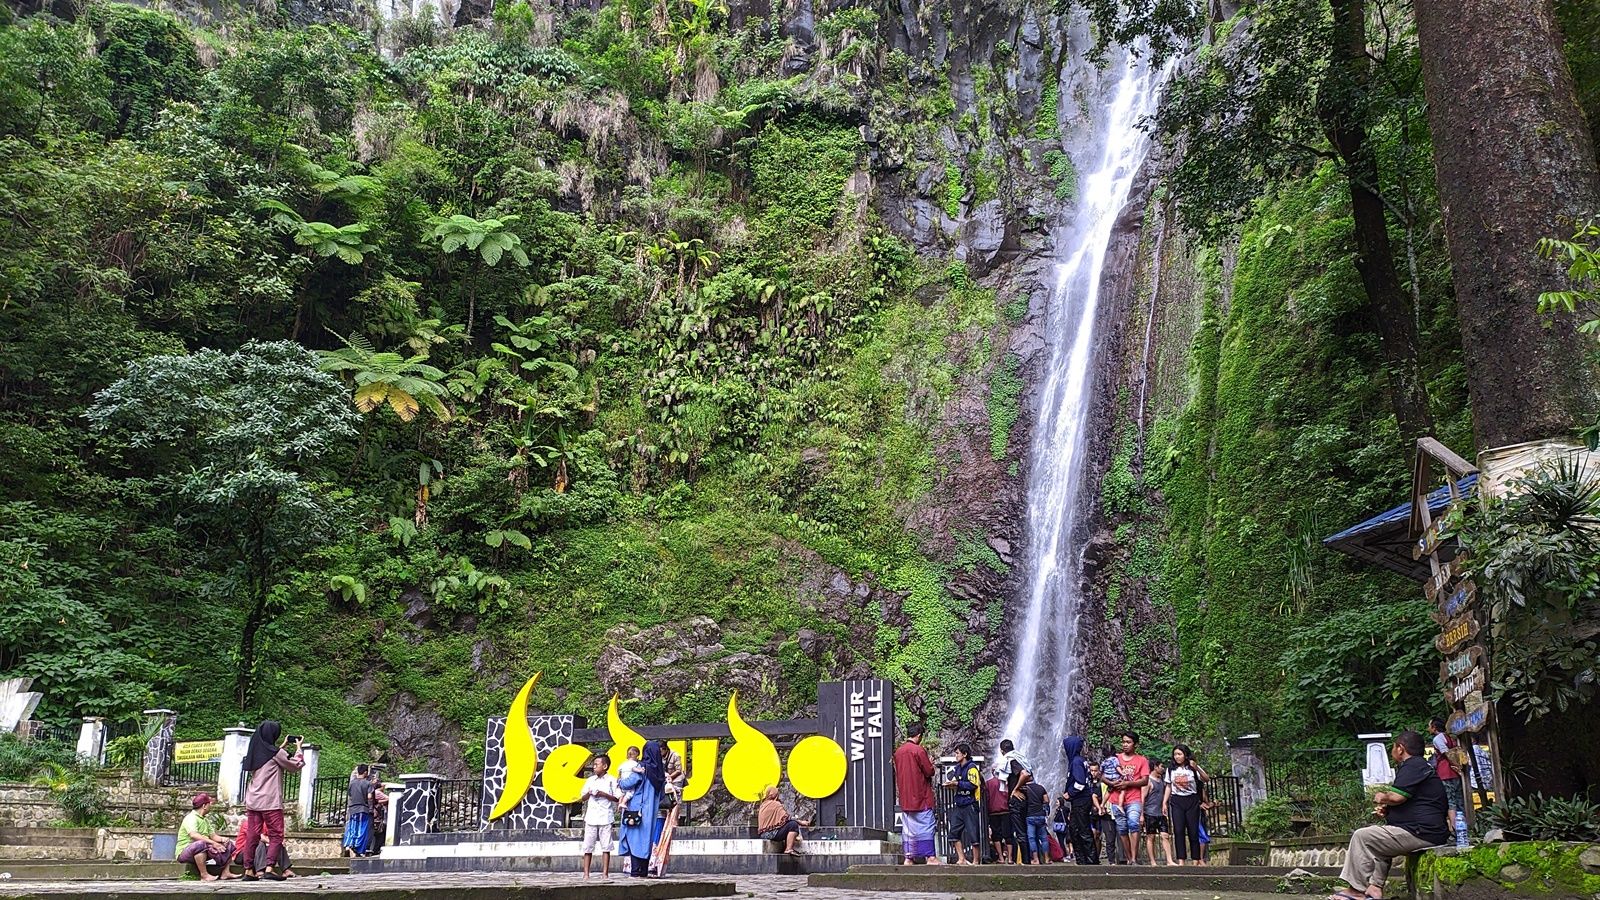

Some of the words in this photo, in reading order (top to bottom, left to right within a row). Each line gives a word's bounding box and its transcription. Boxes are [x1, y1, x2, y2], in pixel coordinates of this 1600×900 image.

[1445, 622, 1469, 647] BERSIH
[1454, 676, 1474, 702] INDAH
[851, 691, 865, 761] WATER
[868, 691, 882, 737] FALL
